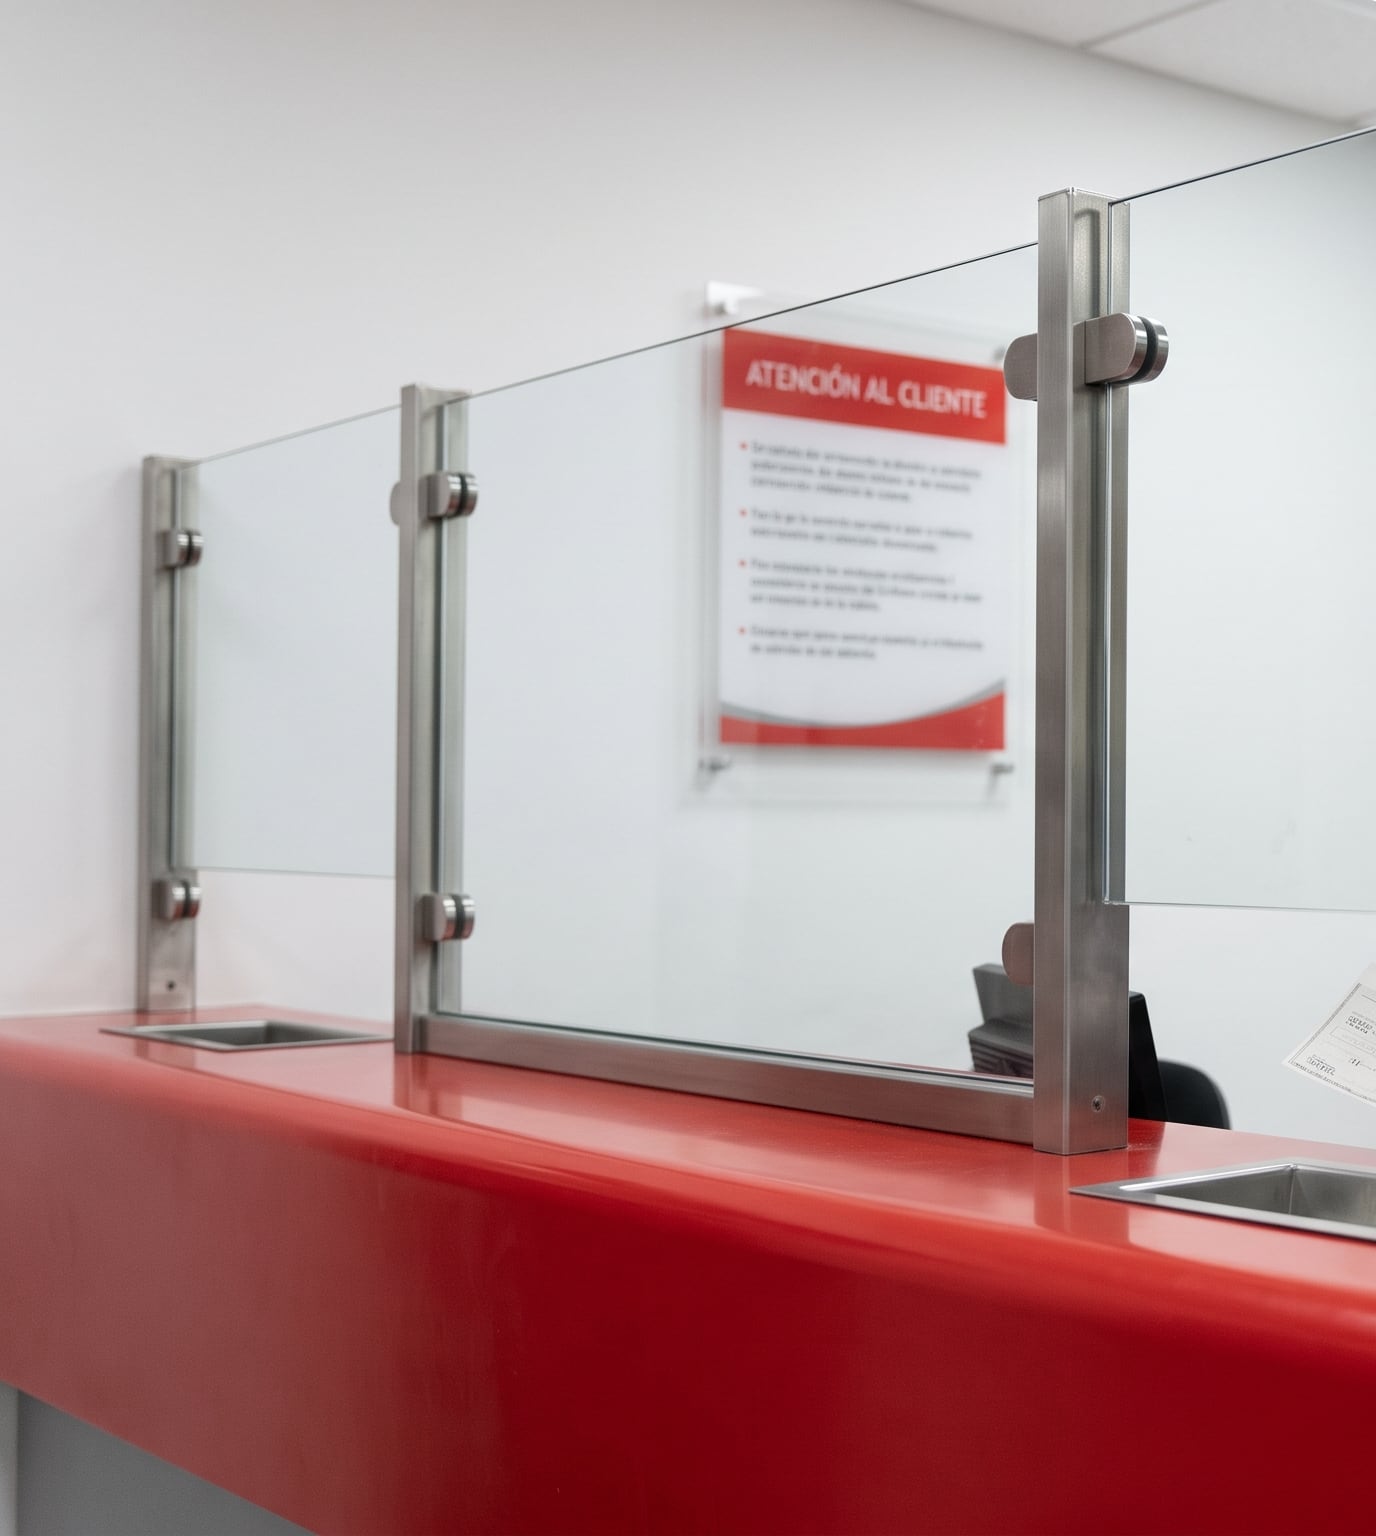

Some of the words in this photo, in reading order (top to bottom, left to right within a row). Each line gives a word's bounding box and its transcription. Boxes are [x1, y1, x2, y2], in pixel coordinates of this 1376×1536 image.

[745, 360, 860, 400] ATENCIÓN
[864, 377, 896, 406] AL
[898, 380, 988, 418] CLIENTE
